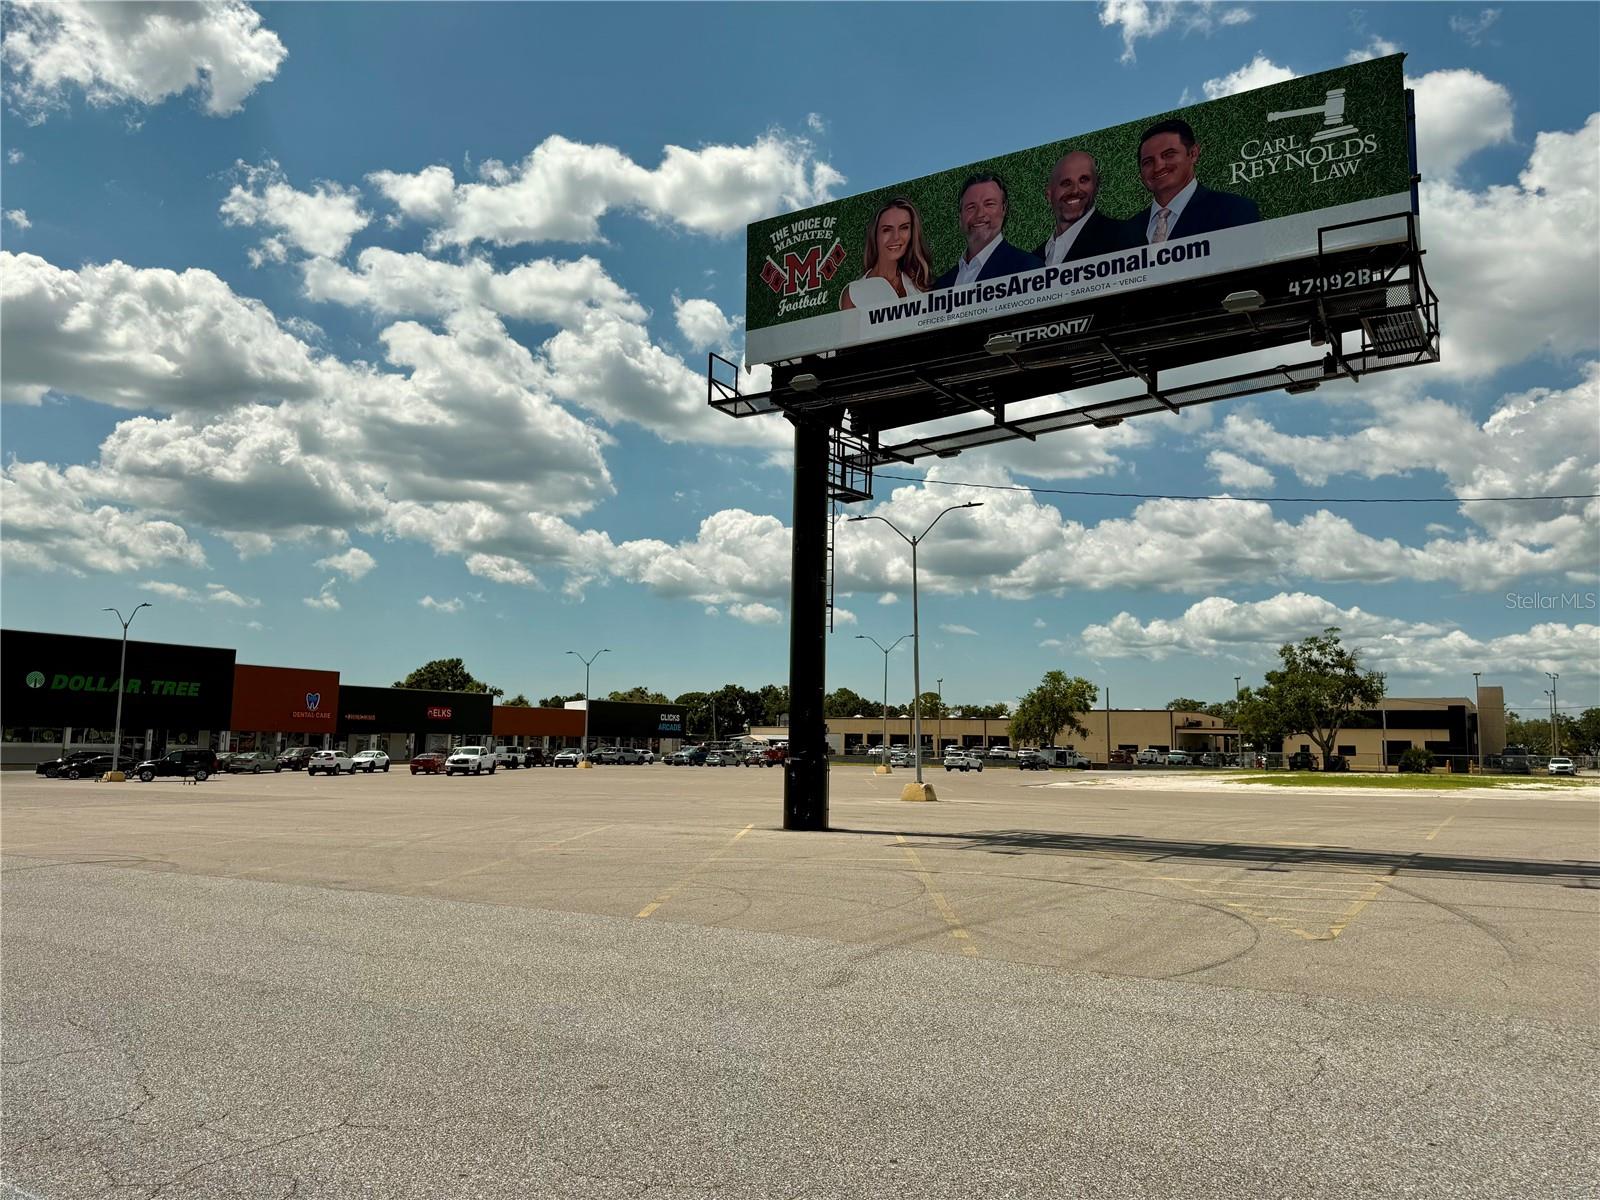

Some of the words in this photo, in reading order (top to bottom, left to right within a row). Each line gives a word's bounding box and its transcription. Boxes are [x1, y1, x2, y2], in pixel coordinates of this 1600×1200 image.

[1229, 134, 1378, 185] REYNOLDS
[1240, 134, 1302, 160] CARL
[1310, 158, 1362, 184] LAW
[769, 225, 789, 244] THE
[790, 217, 821, 234] VOICE
[822, 216, 838, 229] OF
[773, 229, 834, 254] MANATEE
[783, 245, 822, 296] M
[869, 239, 1210, 324] www.InjuriesArePersonal.com
[777, 290, 828, 317] Football
[917, 315, 946, 327] OFFICES:
[946, 307, 988, 321] BRADENTON
[994, 298, 1036, 312] LAKEWOOD
[1036, 292, 1063, 304] RANCH
[1070, 282, 1111, 297] SARASOTA
[1119, 274, 1148, 287] VENICE
[50, 674, 142, 694] DOLLAR
[150, 680, 201, 697] TREE
[315, 711, 332, 719] CARE
[657, 723, 682, 731] ARCADE
[660, 713, 680, 722] CLICKS
